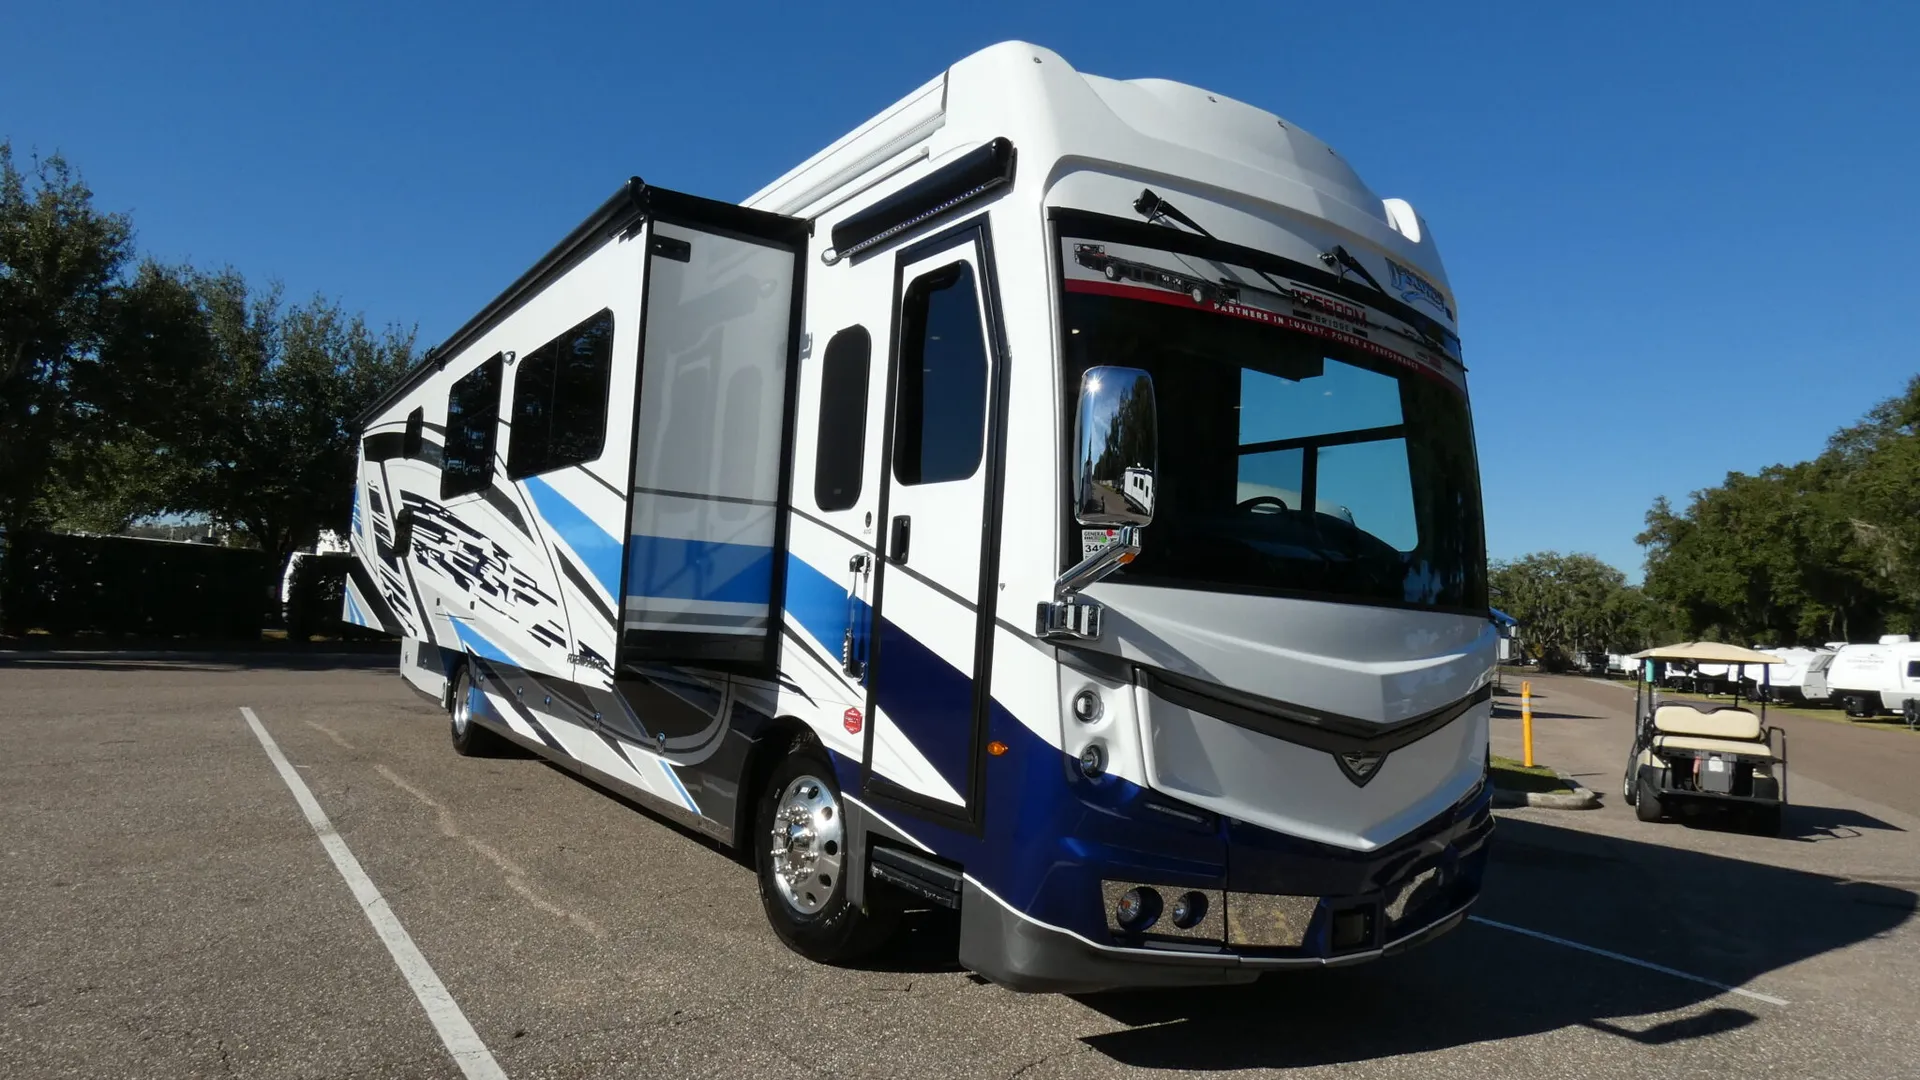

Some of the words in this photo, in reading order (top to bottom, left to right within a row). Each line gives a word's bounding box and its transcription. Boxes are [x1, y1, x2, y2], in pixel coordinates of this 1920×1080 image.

[1213, 303, 1269, 321] PARTNERS
[1273, 315, 1284, 325] IN
[1289, 319, 1328, 336] LUXURY,
[1332, 331, 1360, 346] POWER
[1291, 288, 1367, 329] EEDOM
[1315, 315, 1351, 332] BRIDGE
